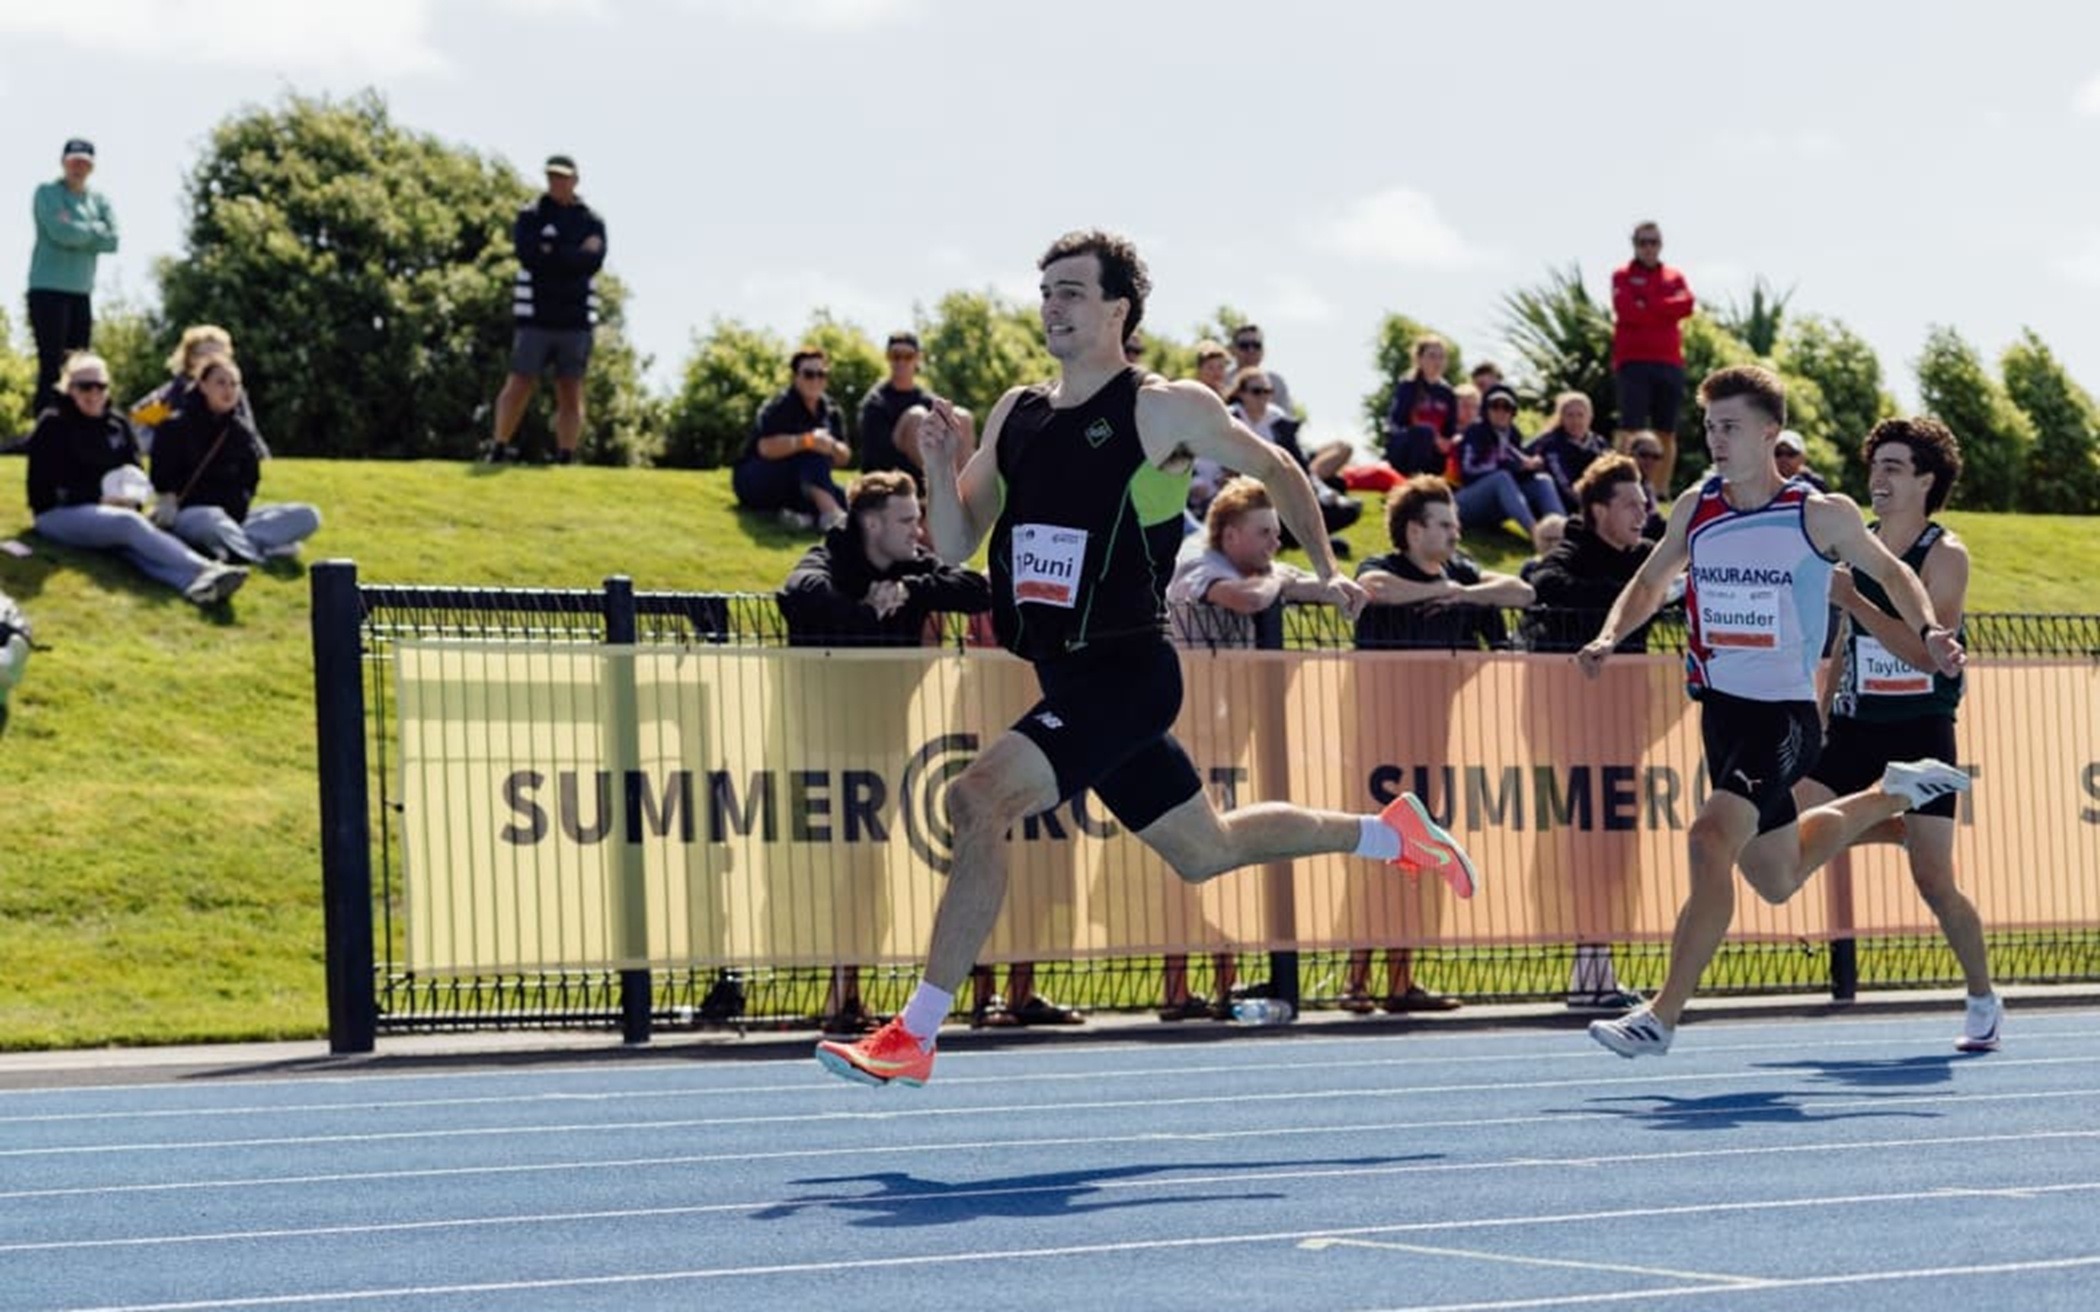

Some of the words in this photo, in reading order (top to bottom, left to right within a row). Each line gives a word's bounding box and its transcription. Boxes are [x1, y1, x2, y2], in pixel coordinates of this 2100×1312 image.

[1693, 567, 1793, 586] PAKURANGA
[1703, 607, 1775, 627] Saunder
[500, 770, 890, 846] SUMMER
[1369, 764, 1683, 832] SUMMER
